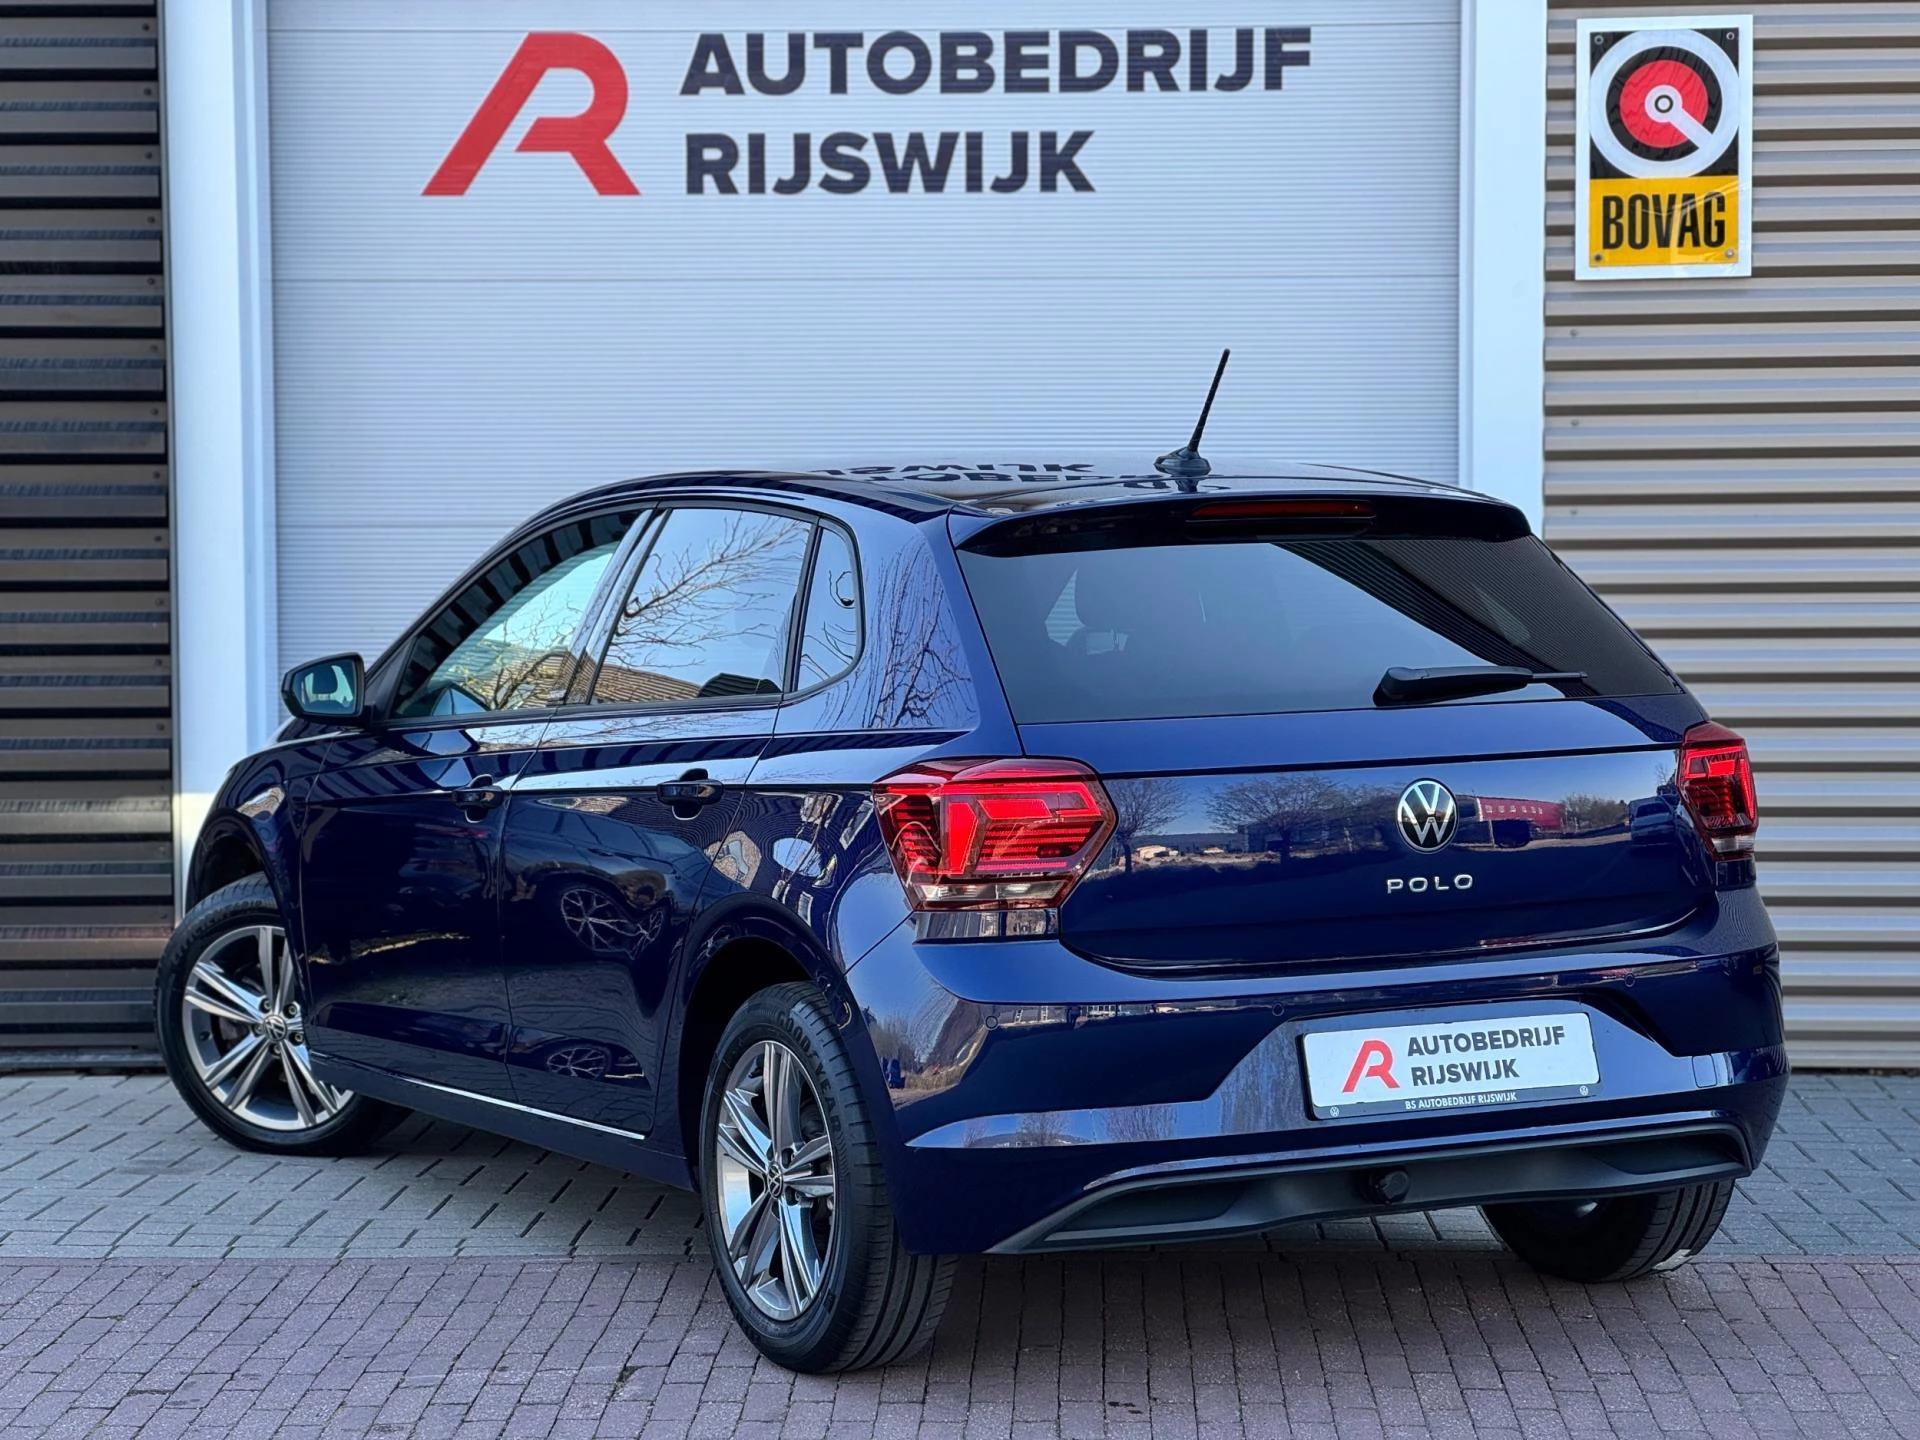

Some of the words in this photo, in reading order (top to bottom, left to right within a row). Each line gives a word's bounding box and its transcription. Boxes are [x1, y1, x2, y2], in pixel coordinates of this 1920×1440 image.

[680, 27, 1312, 97] AUTOBEDRIJF
[685, 130, 1097, 196] RIJSWIJK
[1602, 191, 1727, 250] BOVAG
[1386, 873, 1473, 894] POLO
[1407, 1025, 1566, 1057] AUTOBEDRIJF
[1411, 1058, 1520, 1087] RIJSWIJK
[1405, 1100, 1417, 1110] BS
[1418, 1095, 1477, 1109] AUTOBEDRIJF
[1477, 1091, 1517, 1104] RIJSWIJK
